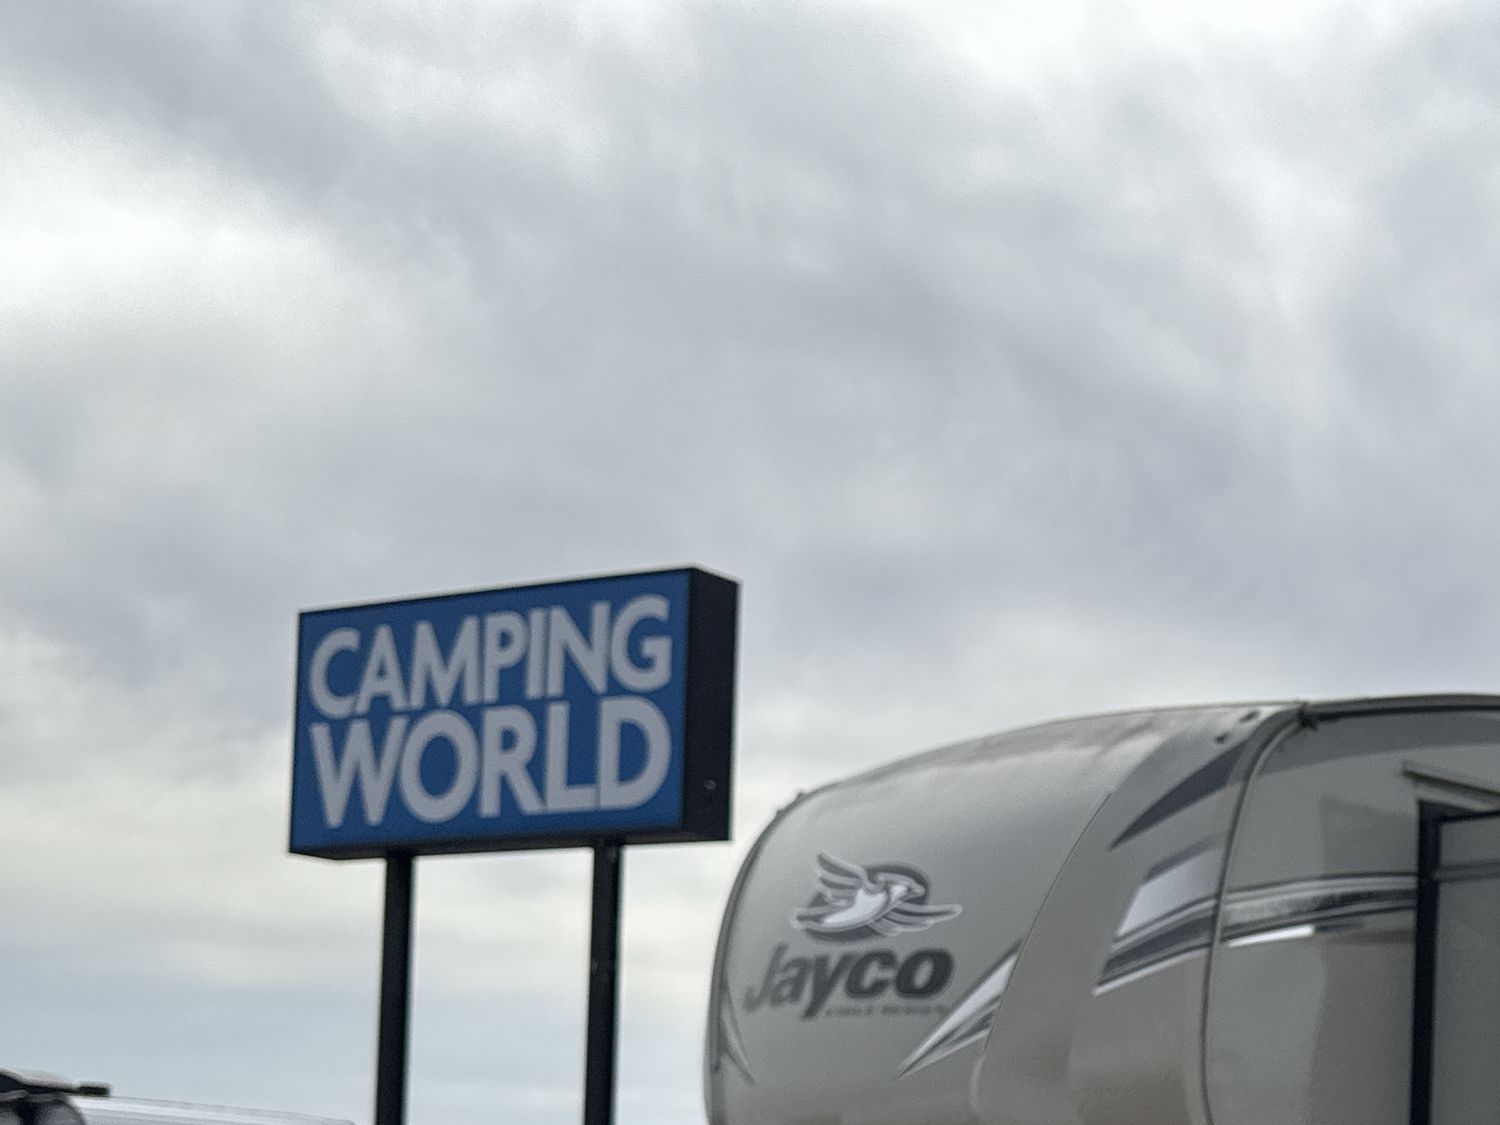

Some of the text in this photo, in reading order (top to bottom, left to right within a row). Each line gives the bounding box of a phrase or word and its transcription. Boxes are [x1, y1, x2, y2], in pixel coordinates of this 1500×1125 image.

[310, 596, 671, 718] CAMPING
[310, 696, 671, 827] WORLD
[742, 944, 955, 1022] Jayco
